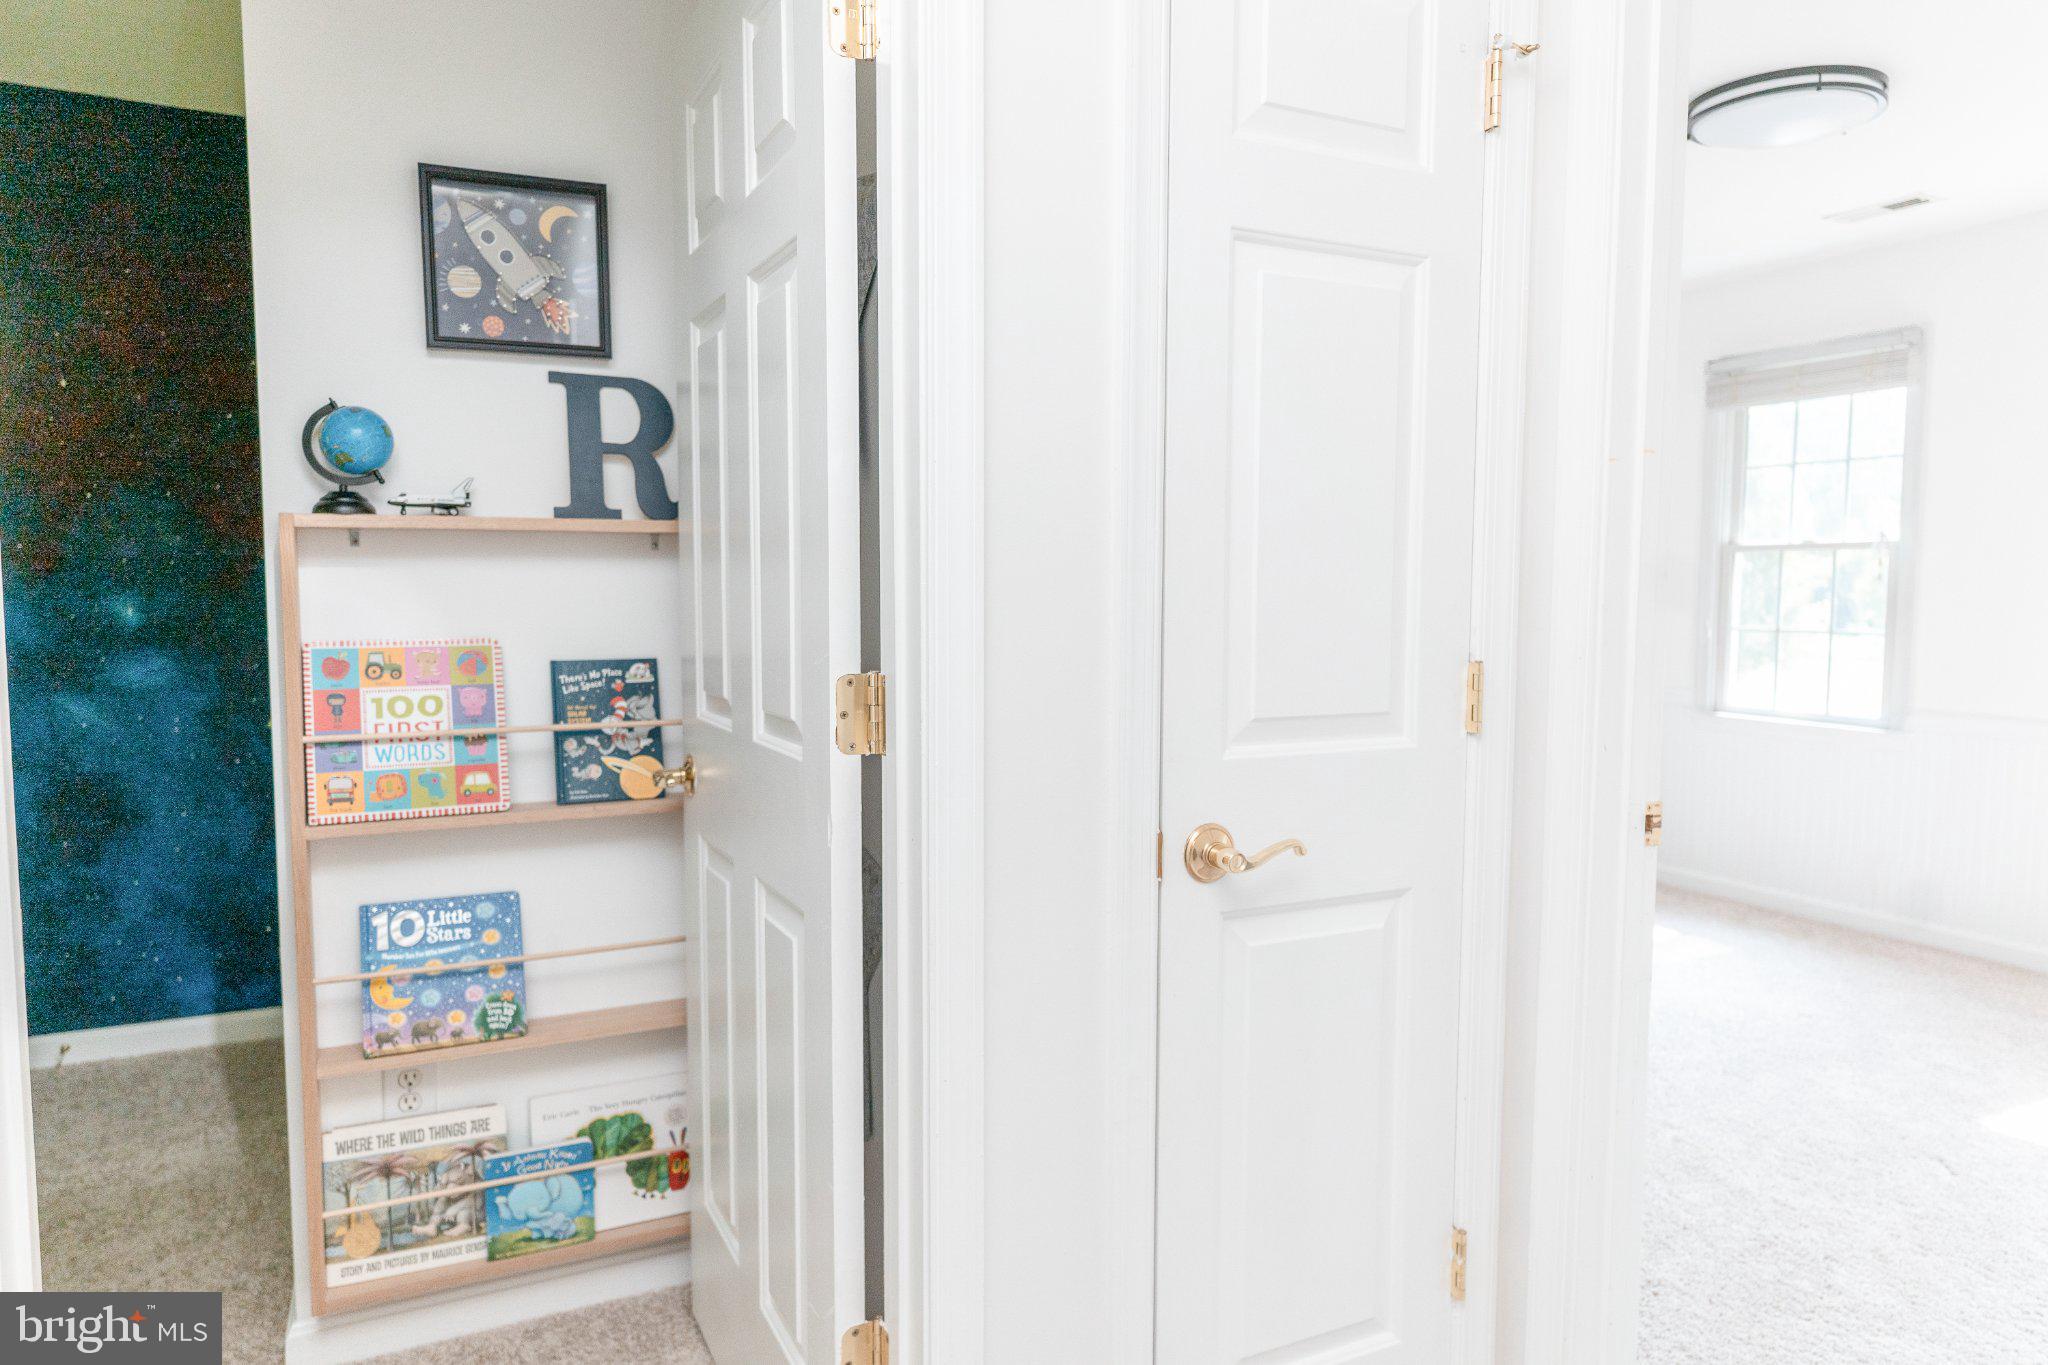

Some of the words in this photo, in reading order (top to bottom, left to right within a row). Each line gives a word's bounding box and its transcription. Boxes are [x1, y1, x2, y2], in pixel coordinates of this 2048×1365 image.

[548, 371, 679, 520] R
[559, 672, 587, 685] There's
[589, 670, 601, 679] No
[602, 668, 622, 678] Place
[562, 684, 579, 695] Like
[580, 678, 606, 692] Space!
[371, 694, 443, 719] 100
[374, 720, 444, 743] FIRST
[374, 742, 446, 763] WORDS
[426, 909, 472, 927] Little
[371, 909, 425, 952] 10
[426, 927, 472, 944] Stars
[335, 1135, 373, 1156] WHERE
[376, 1132, 396, 1149] THE
[400, 1128, 425, 1145] WILD
[429, 1121, 467, 1140] THINGS
[471, 1117, 491, 1133] ARE
[340, 1265, 363, 1278] STORY
[366, 1261, 382, 1272] AND
[384, 1254, 418, 1269] PICTURES
[420, 1252, 430, 1263] BY
